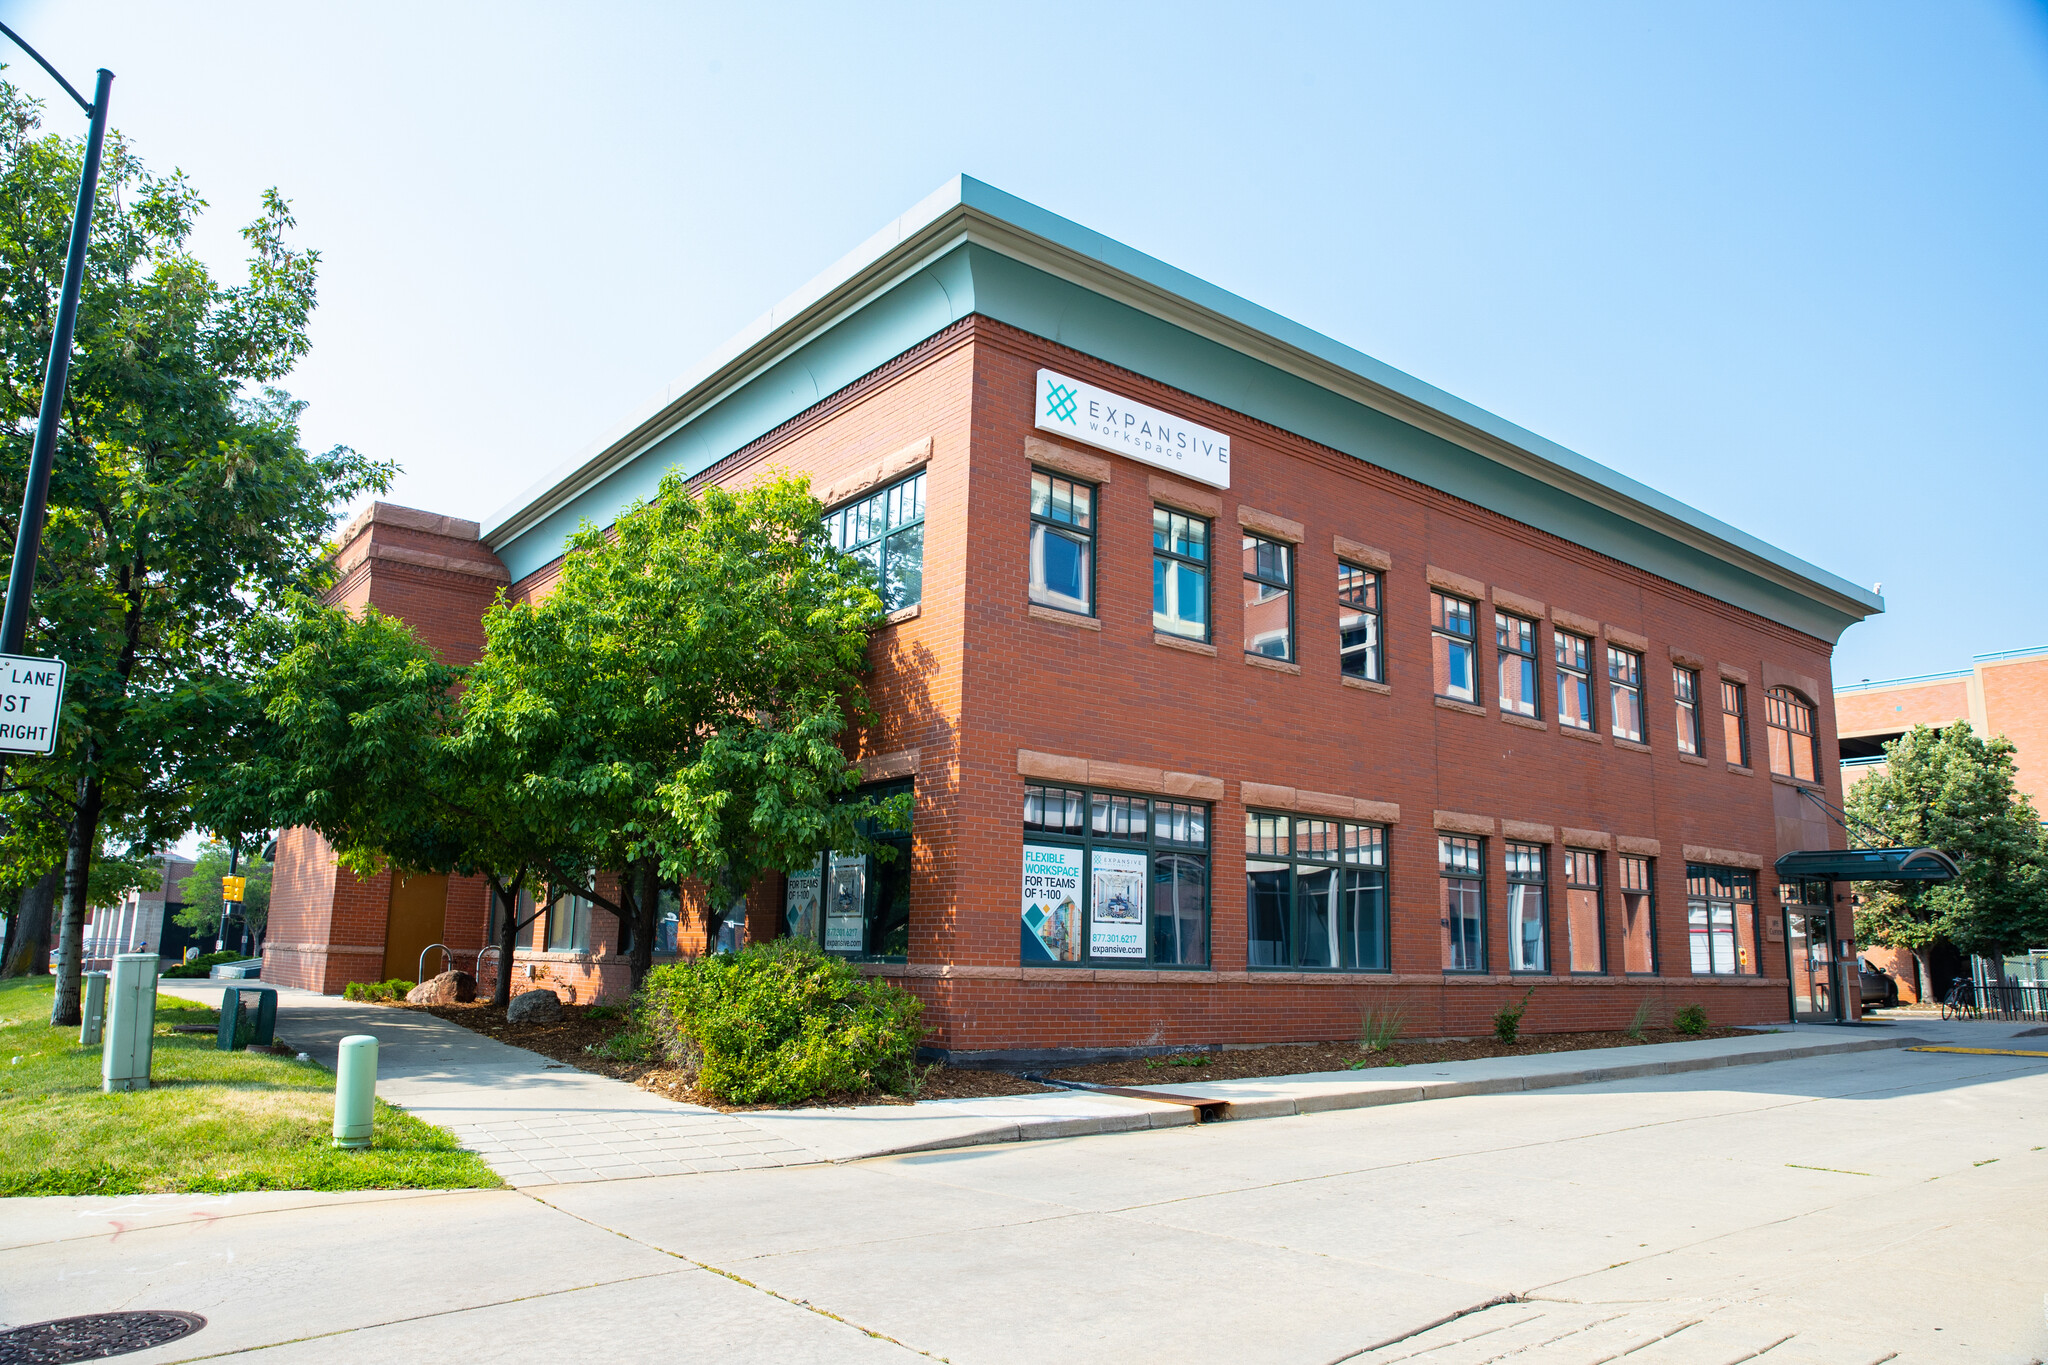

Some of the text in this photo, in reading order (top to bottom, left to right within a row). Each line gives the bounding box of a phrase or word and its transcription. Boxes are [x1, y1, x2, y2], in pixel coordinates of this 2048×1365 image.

[1089, 400, 1228, 464] EXPANSIVE
[1089, 421, 1183, 460] workspace
[12, 669, 56, 687] LANE
[0, 694, 31, 713] ST
[0, 723, 48, 741] RIGHT
[1025, 851, 1064, 864] FLEXIBLE
[1104, 857, 1142, 866] EXPANSIVE
[1025, 863, 1079, 877] WORKSPACE
[790, 879, 818, 889] FOR TEAMS
[1025, 876, 1075, 888] FOR TEAMS
[789, 890, 810, 900] OF 1-100
[1025, 888, 1061, 900] OF 1-100
[827, 938, 861, 948] expansive.com
[1092, 933, 1137, 943] 877.301.6217
[1092, 945, 1142, 954] expansive.com
